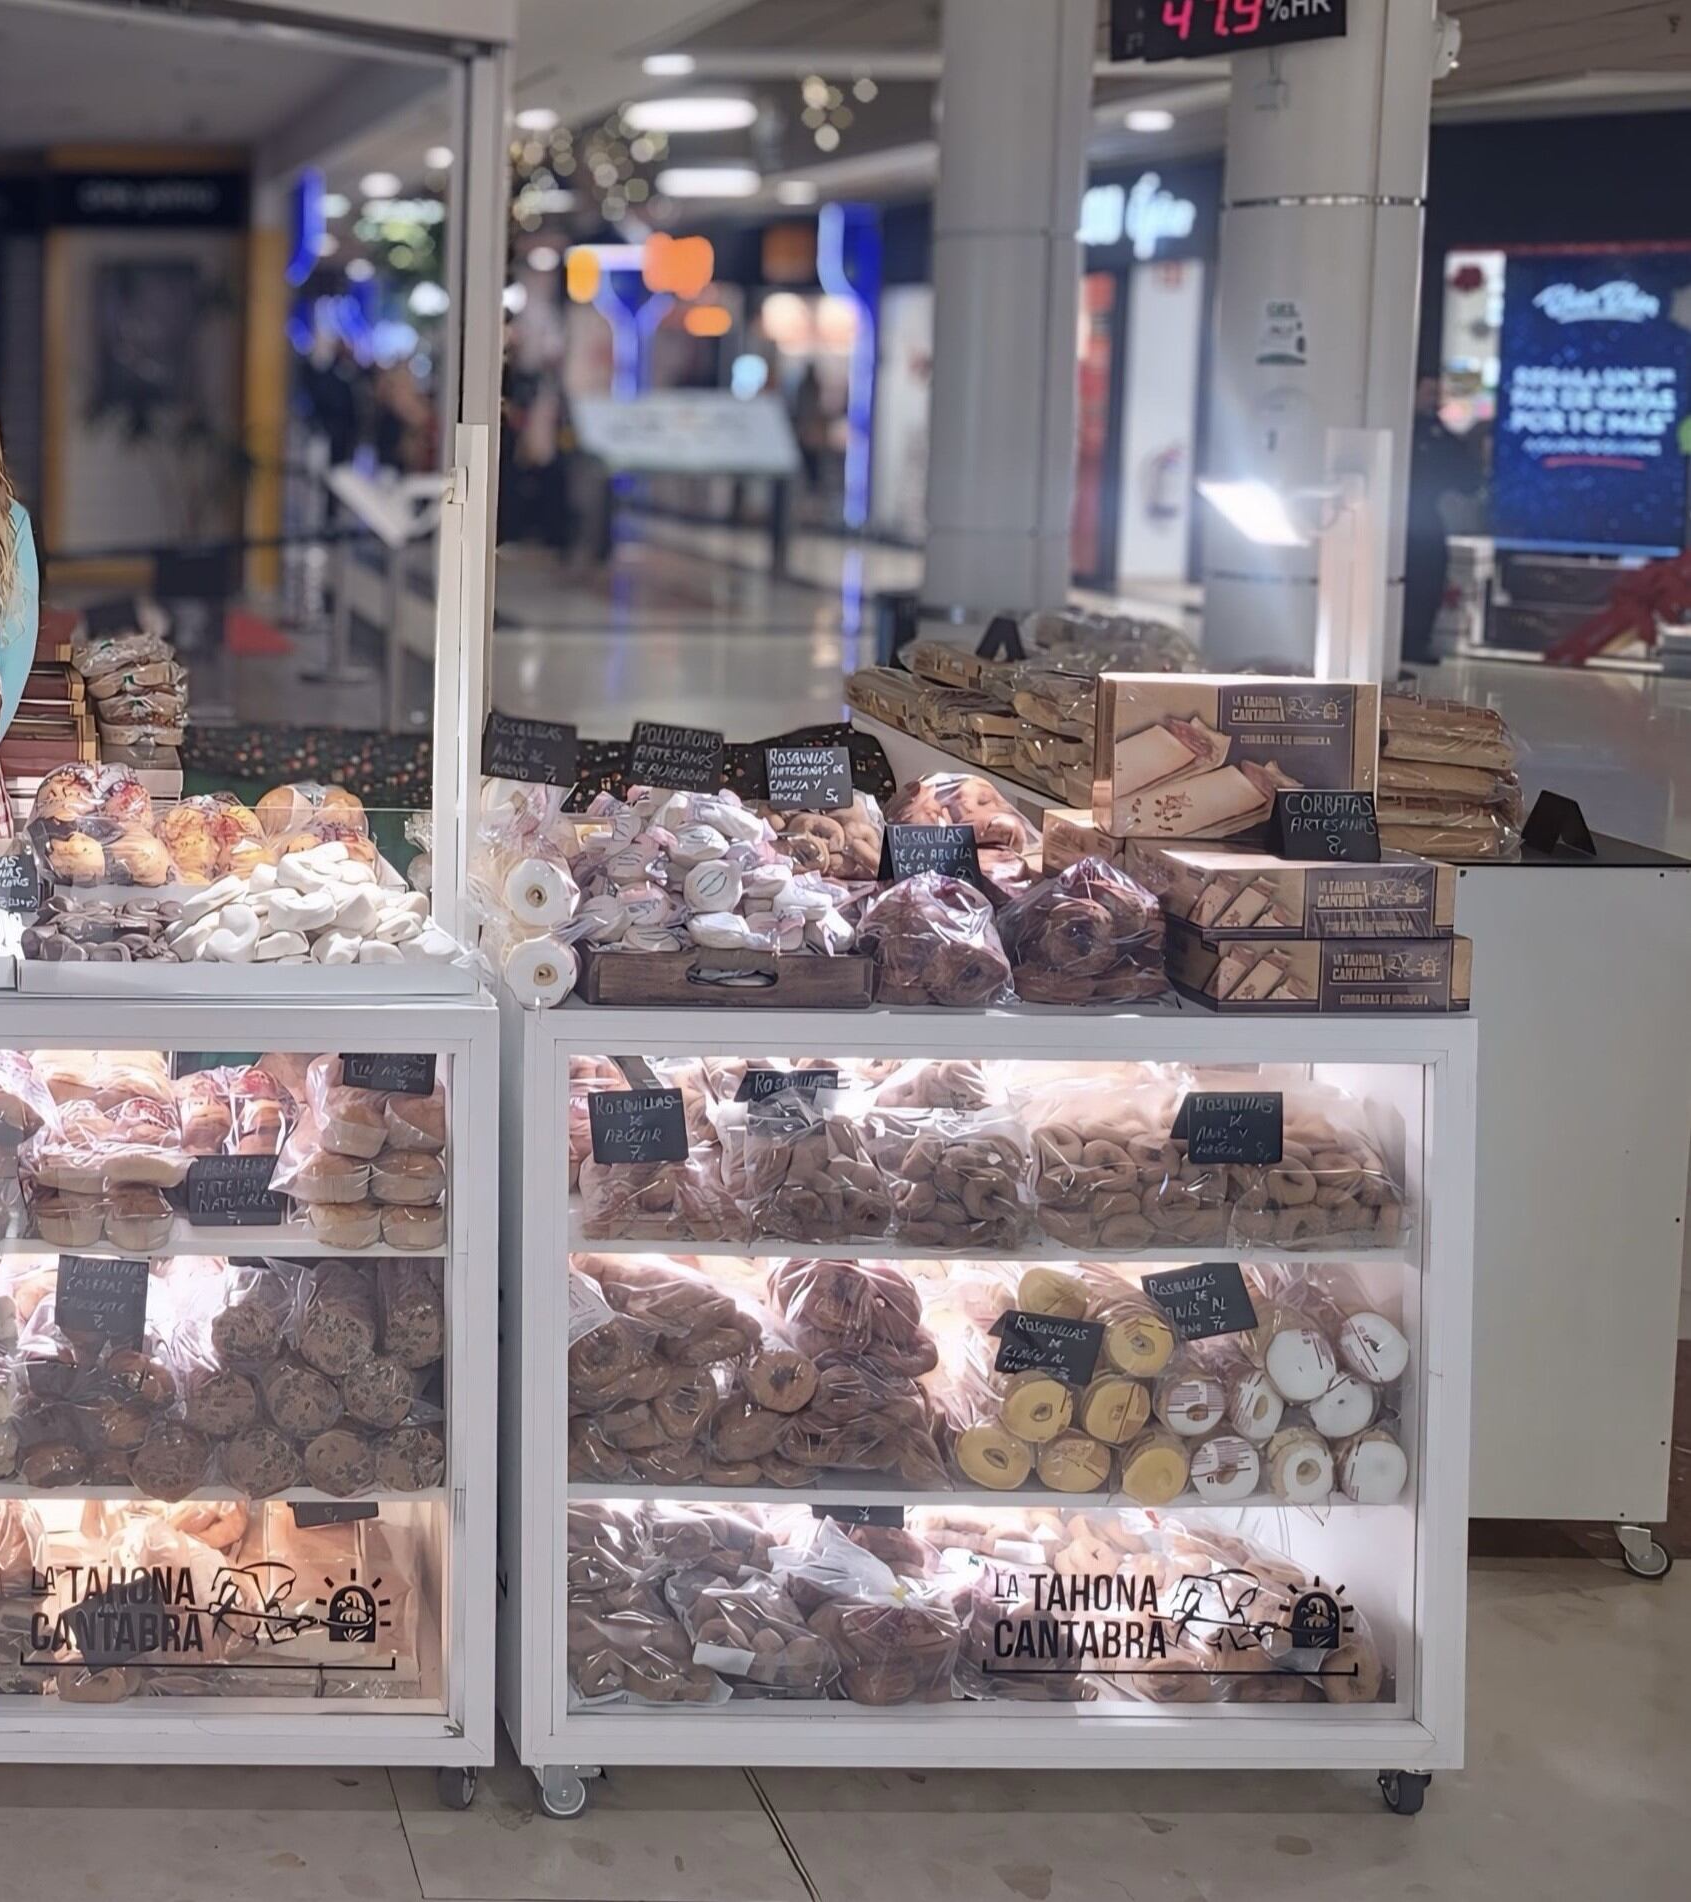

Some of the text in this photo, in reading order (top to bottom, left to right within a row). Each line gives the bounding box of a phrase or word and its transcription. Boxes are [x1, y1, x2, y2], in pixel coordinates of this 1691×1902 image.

[1285, 793, 1373, 816] CORBATAS
[31, 1565, 195, 1604] LA TAHONA
[994, 1572, 1158, 1612] LA TAHONA
[31, 1612, 203, 1652] CANTABRA
[993, 1619, 1167, 1659] CANTABRA
